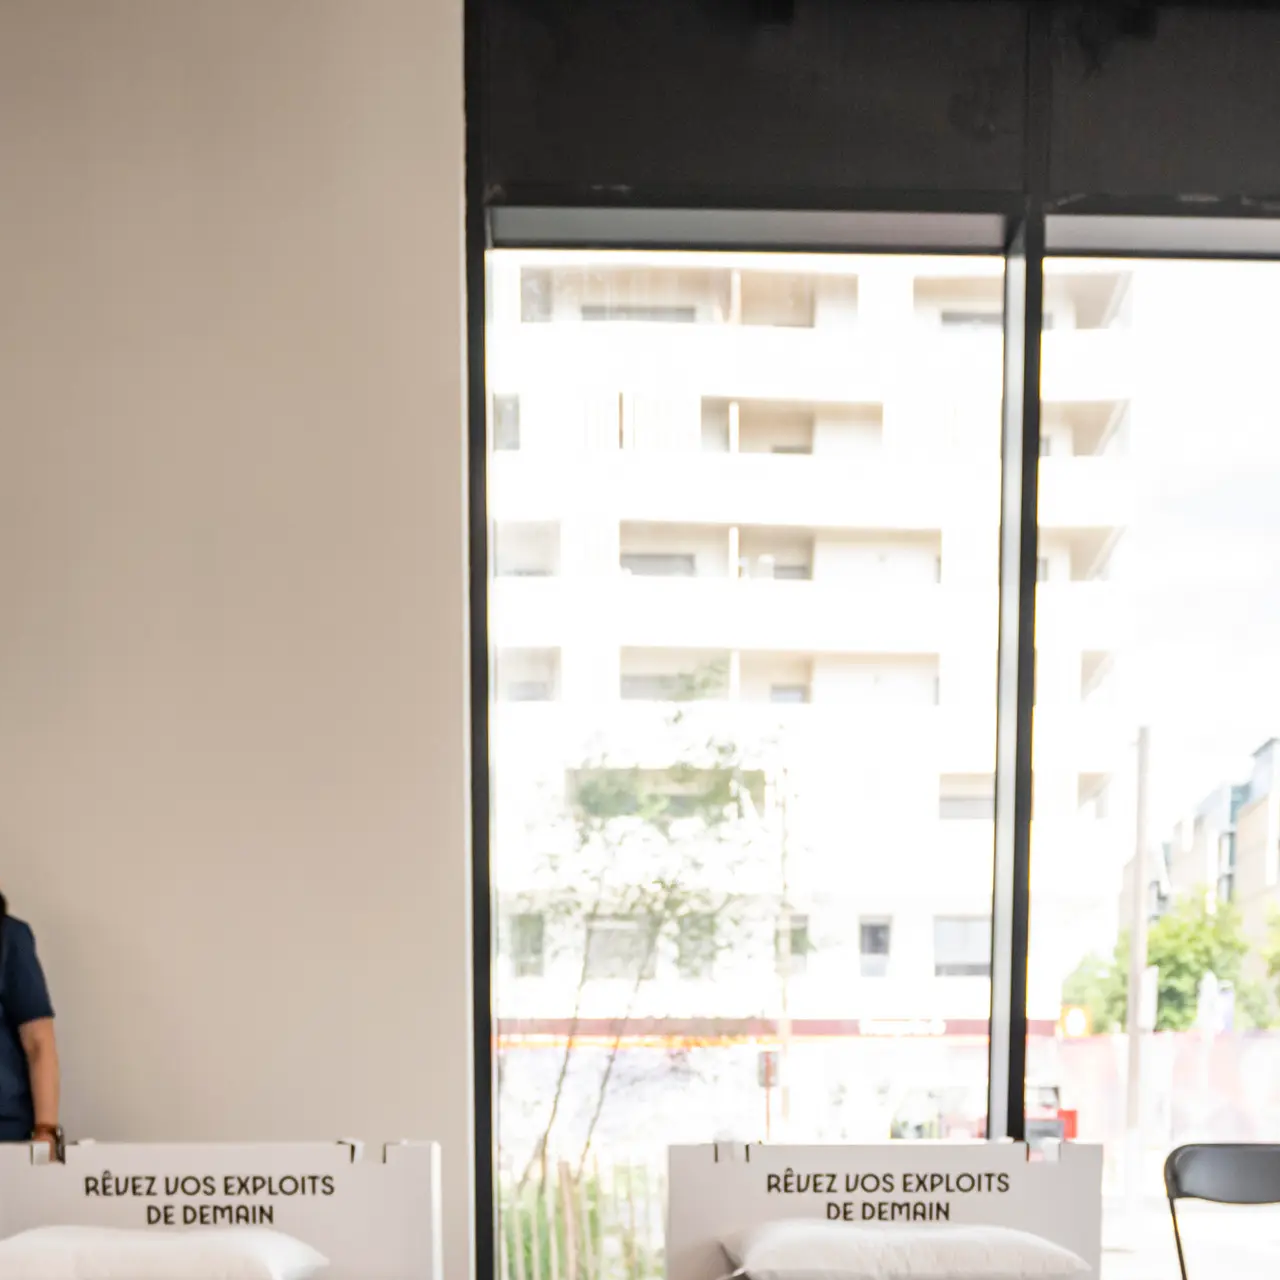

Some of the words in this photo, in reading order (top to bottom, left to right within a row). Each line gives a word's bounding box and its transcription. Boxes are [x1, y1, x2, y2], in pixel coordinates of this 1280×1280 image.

[84, 1170, 157, 1196] RÊVEZ
[165, 1176, 216, 1196] VOS
[224, 1175, 335, 1196] EXPLOITS
[767, 1168, 838, 1193] RÊVEZ
[845, 1173, 894, 1193] VOS
[902, 1173, 1010, 1193] EXPLOITS
[146, 1205, 175, 1225] DE
[183, 1205, 274, 1225] DEMAIN
[826, 1202, 854, 1221] DE
[862, 1202, 950, 1221] DEMAIN
